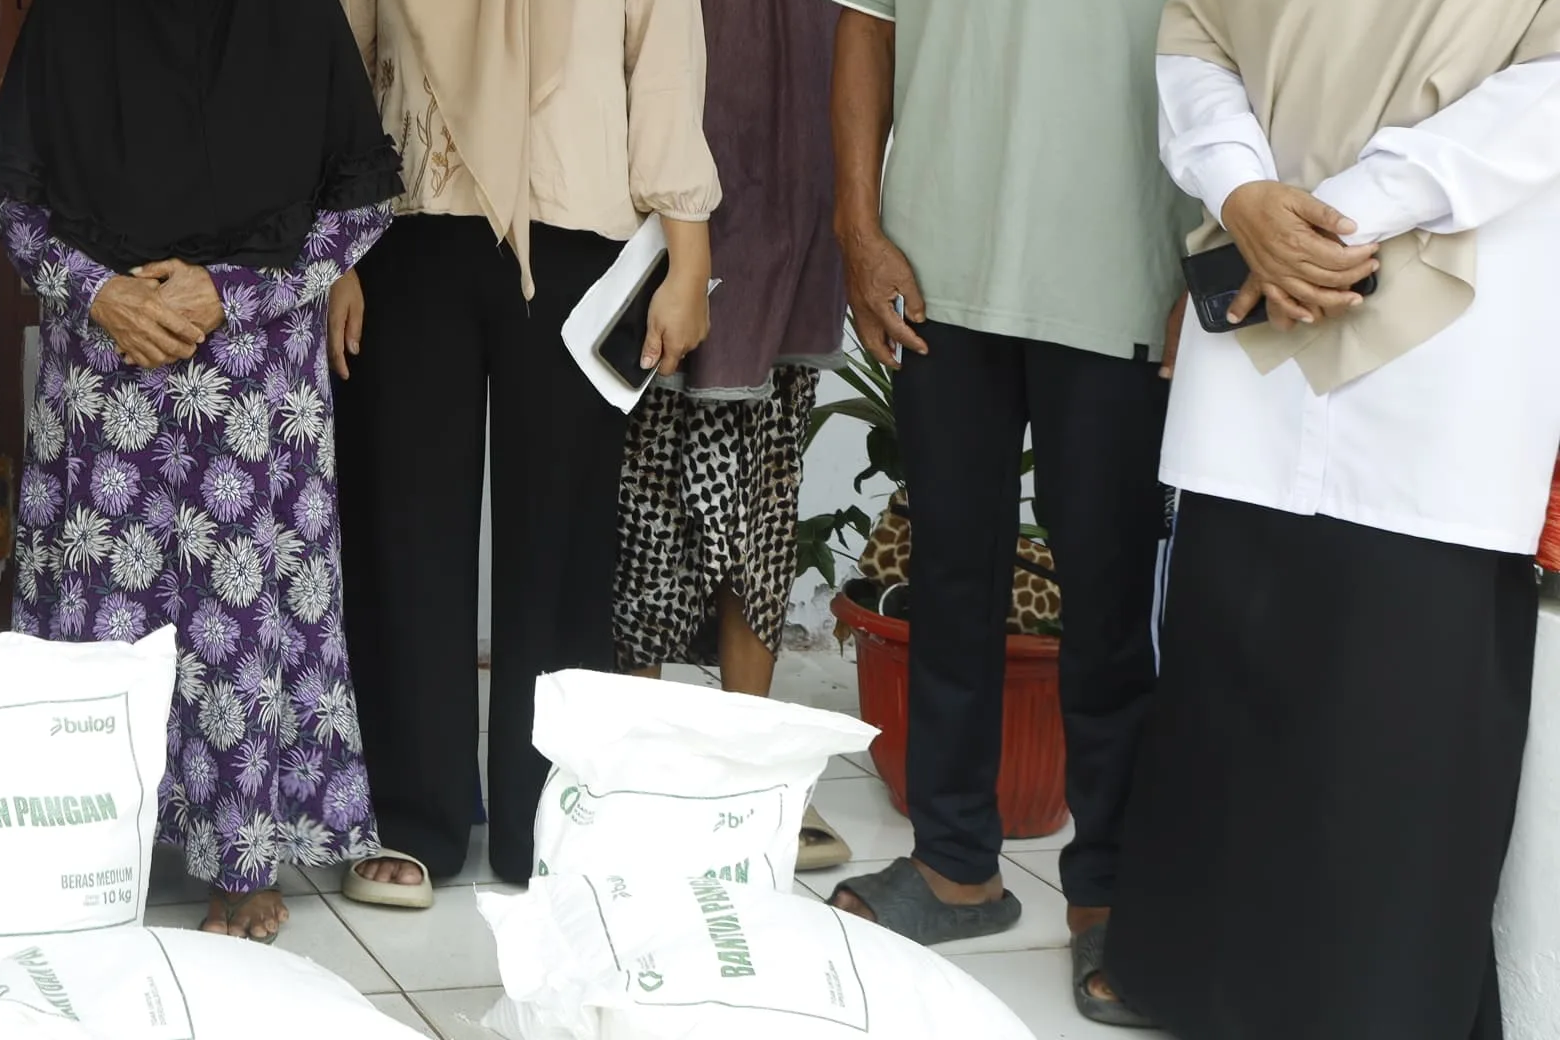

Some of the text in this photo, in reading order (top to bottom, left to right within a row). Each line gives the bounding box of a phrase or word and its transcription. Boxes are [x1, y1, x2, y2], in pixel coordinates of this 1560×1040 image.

[62, 713, 116, 737] bulog
[15, 792, 117, 827] PANGAN
[61, 865, 133, 889] BERAS MEDIUM
[102, 890, 116, 904] 10
[119, 888, 132, 904] kg
